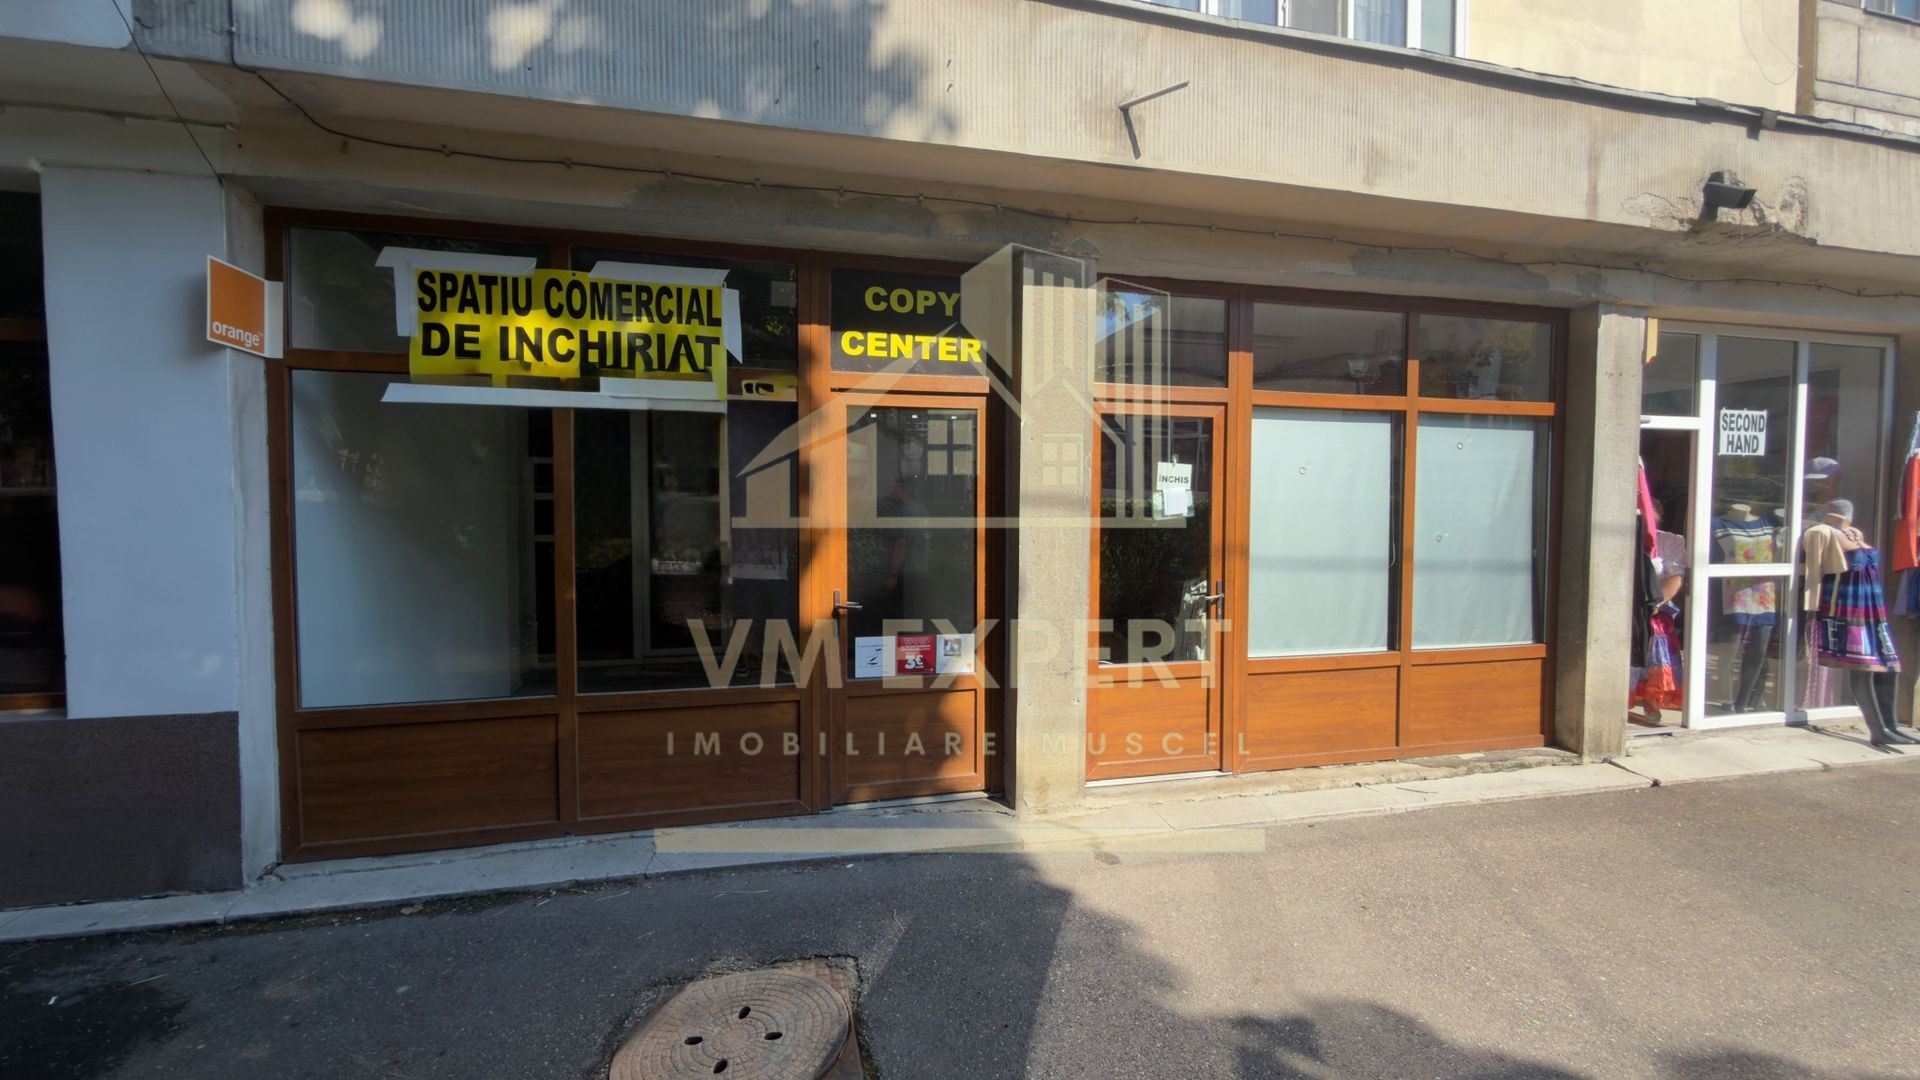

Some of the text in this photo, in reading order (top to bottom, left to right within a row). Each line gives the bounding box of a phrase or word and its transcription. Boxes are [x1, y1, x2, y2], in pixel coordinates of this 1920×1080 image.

[417, 270, 722, 327] SPATIU COMERCIAL
[864, 286, 961, 317] COPY
[212, 321, 260, 347] orange
[421, 322, 720, 372] DE INCHIRIAT
[840, 331, 982, 363] CENTER
[1722, 413, 1765, 432] SECOND
[1726, 434, 1759, 453] HAND
